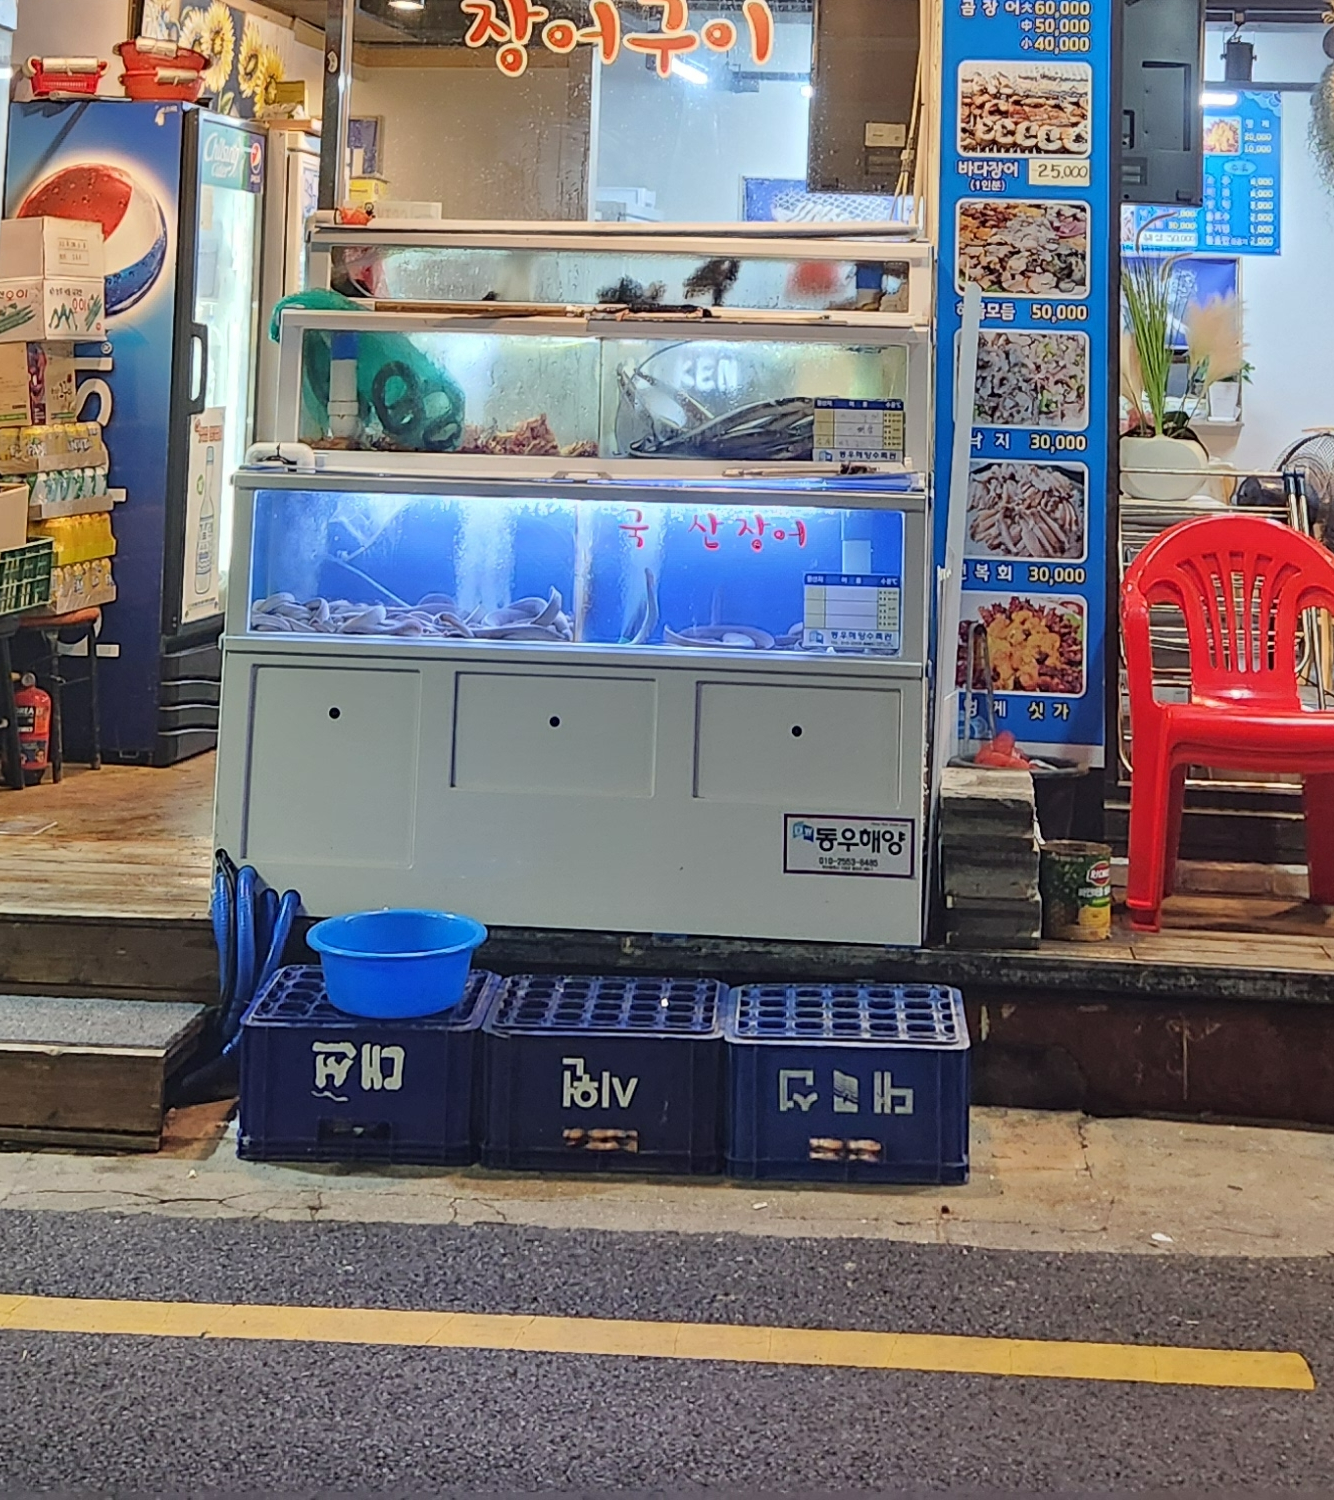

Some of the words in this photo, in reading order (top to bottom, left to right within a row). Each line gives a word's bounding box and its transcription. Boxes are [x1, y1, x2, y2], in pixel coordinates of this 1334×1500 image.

[957, 160, 1019, 179] 바다장어
[1032, 303, 1087, 323] 50,000
[1030, 433, 1087, 454] 30,000
[1028, 565, 1085, 586] 30,000
[815, 827, 906, 856] 동우해양
